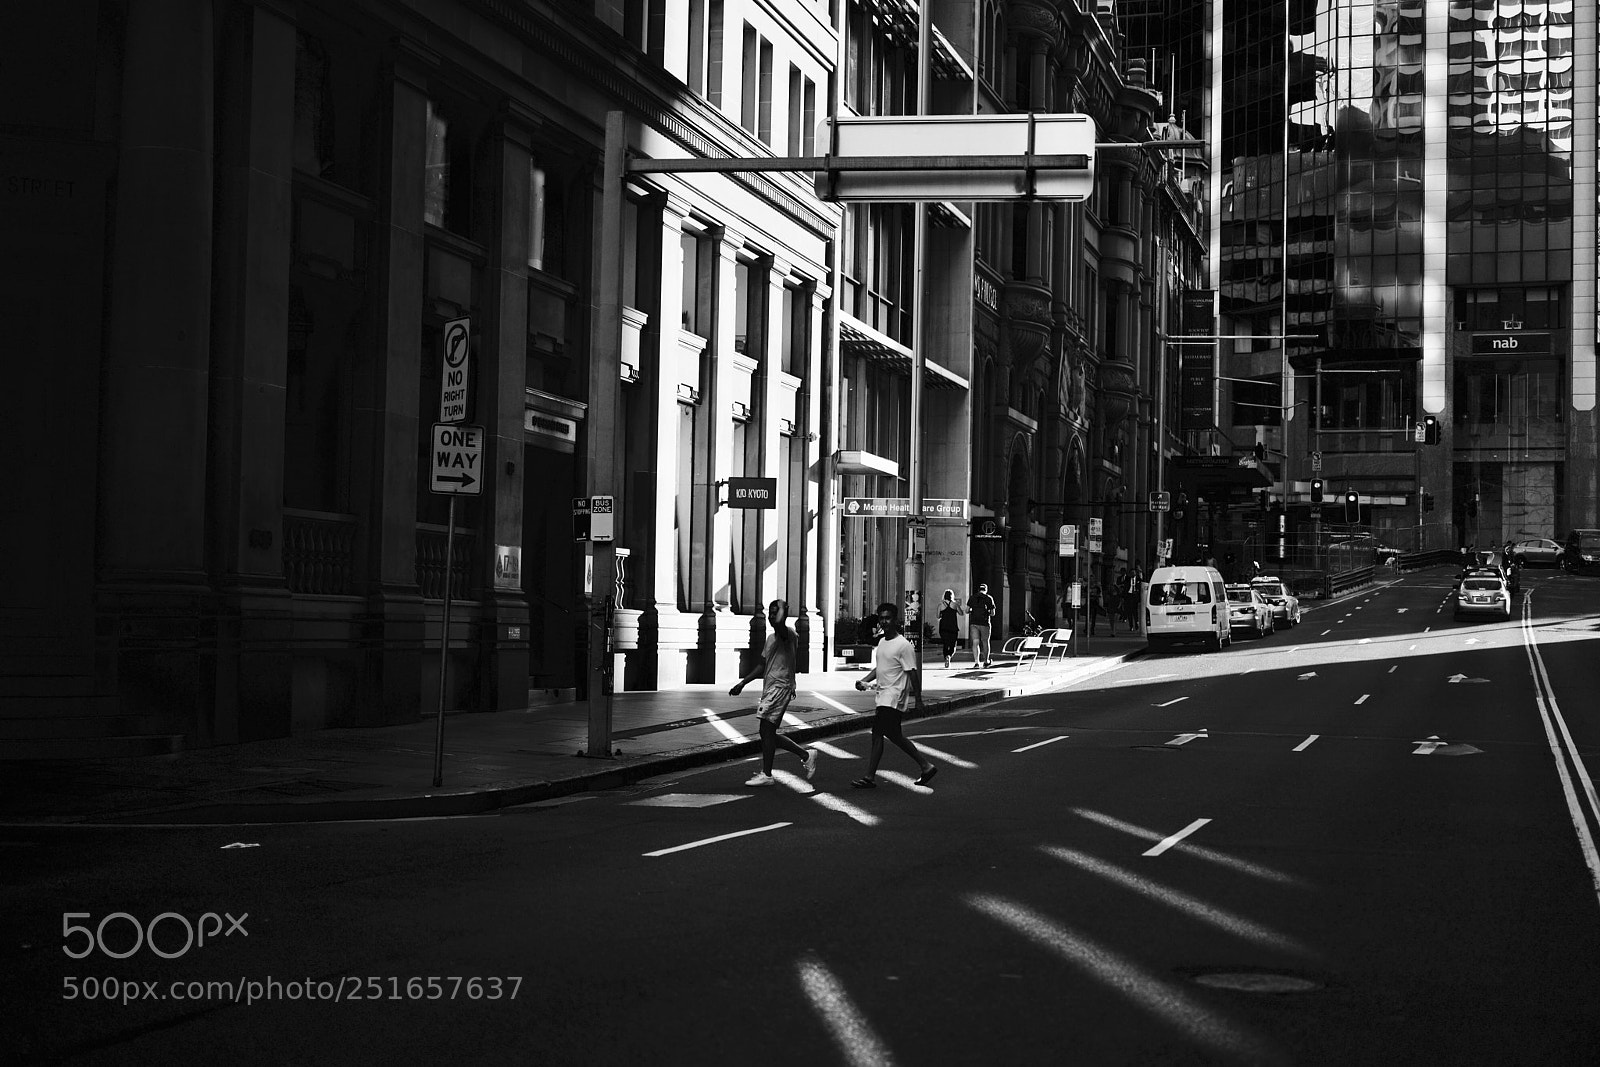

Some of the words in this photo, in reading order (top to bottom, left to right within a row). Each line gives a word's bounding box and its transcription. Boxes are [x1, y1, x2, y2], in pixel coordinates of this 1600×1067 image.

[1492, 336, 1519, 349] nab
[447, 370, 463, 387] NO
[443, 388, 465, 403] RIGHT
[443, 404, 464, 417] TURN
[440, 430, 476, 448] ONE
[437, 451, 478, 469] WAY
[735, 488, 747, 499] KID
[747, 488, 769, 500] KYOTO
[594, 499, 610, 507] BUS
[863, 503, 888, 511] Moran
[889, 503, 910, 512] Healt
[936, 503, 961, 513] Group
